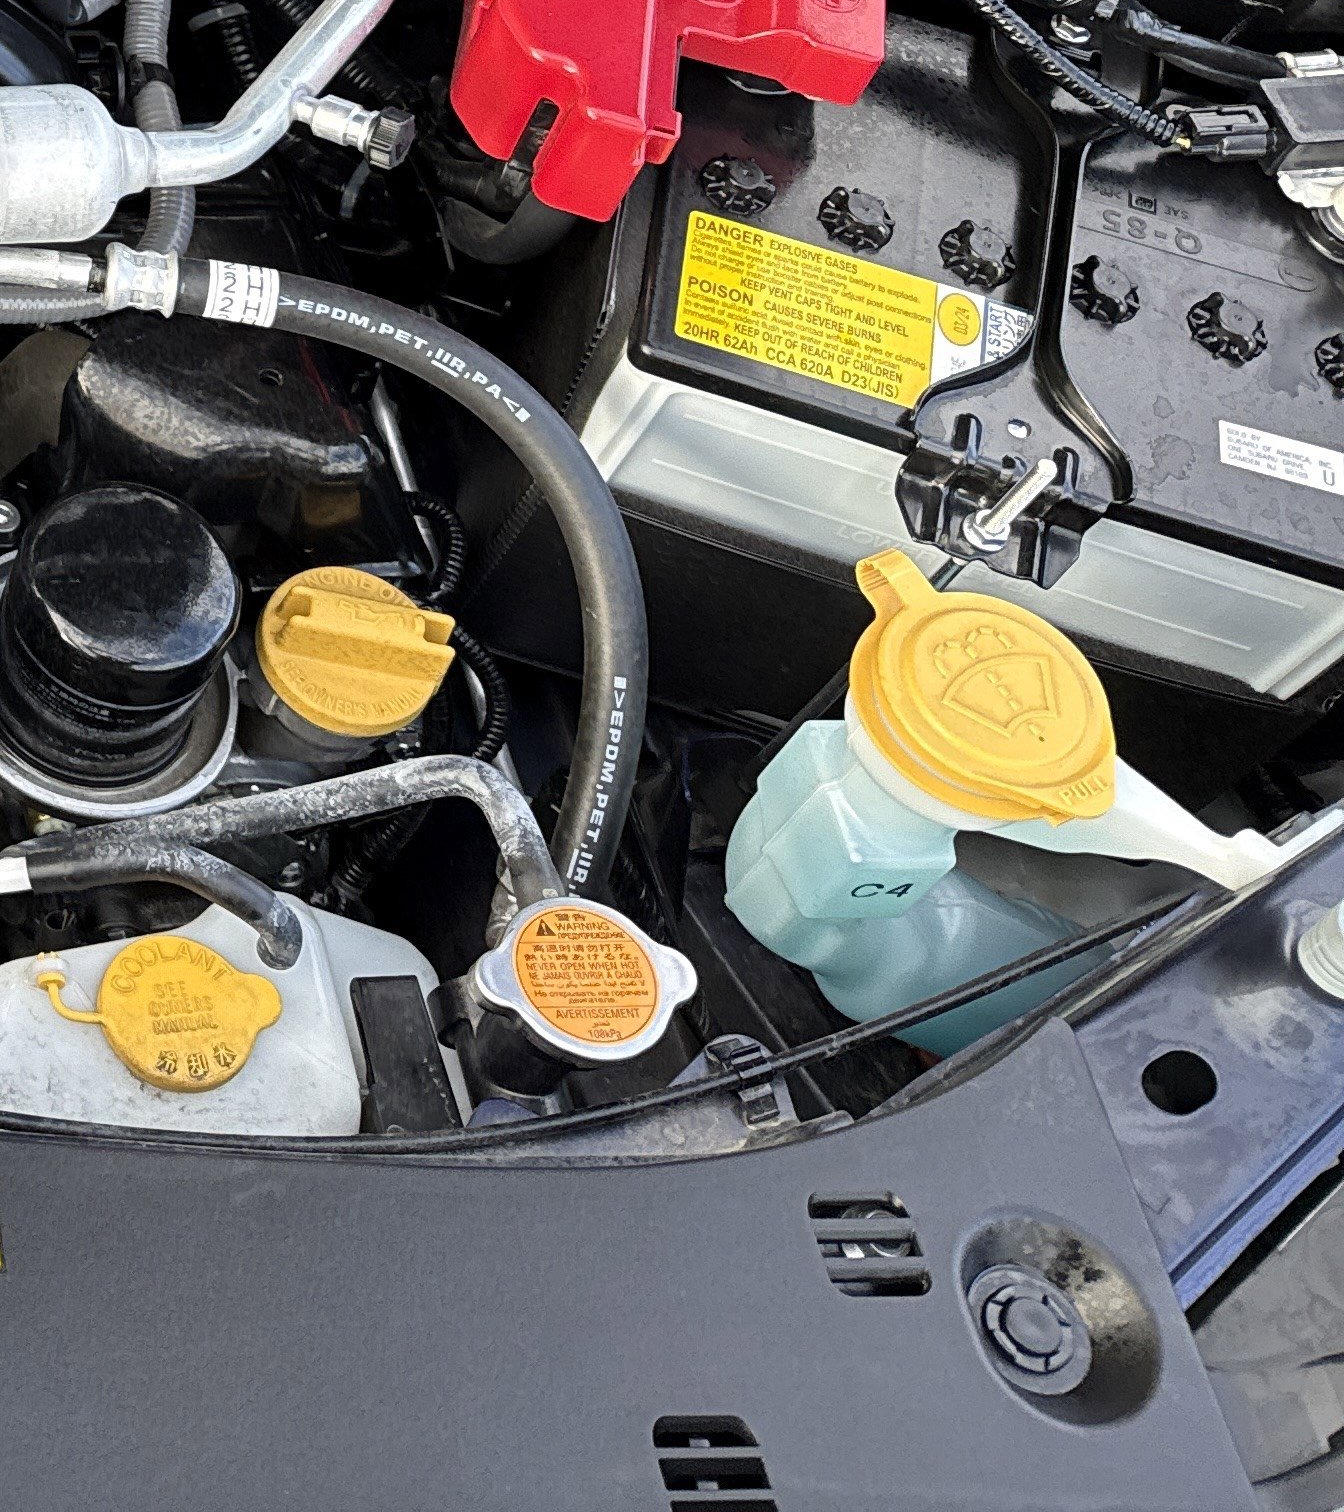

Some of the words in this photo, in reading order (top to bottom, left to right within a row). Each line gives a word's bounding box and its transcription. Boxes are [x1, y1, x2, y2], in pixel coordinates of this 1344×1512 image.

[695, 217, 764, 248] DANGER
[769, 239, 823, 264] EXPLOSIVE
[825, 256, 858, 275] GASES
[1102, 209, 1202, 254] Q-85
[690, 254, 717, 267] without
[720, 263, 744, 275] proper
[746, 270, 785, 287] instruction
[787, 282, 802, 292] and
[692, 238, 719, 252] Always
[802, 270, 819, 280] from
[691, 245, 702, 254] Do
[704, 249, 716, 258] not
[718, 254, 745, 268] charge
[747, 262, 755, 270] or
[757, 265, 770, 274] use
[831, 287, 839, 295] or
[841, 291, 865, 304] adjust
[866, 298, 884, 309] post
[885, 303, 932, 324] connections
[849, 276, 876, 291] battery
[878, 285, 886, 293] to
[688, 275, 754, 307] POISON
[763, 300, 804, 321] CAUSES
[806, 313, 844, 334] SEVERE
[847, 325, 882, 344] BURNS
[740, 277, 766, 293] KEEP
[768, 285, 794, 301] VENT
[795, 293, 822, 311] CAPS
[824, 302, 854, 320] TIGHT
[854, 311, 876, 327] AND
[878, 318, 909, 338] LEVEL
[693, 301, 715, 314] event
[717, 308, 725, 316] of
[727, 311, 759, 326] accident
[823, 341, 838, 351] and
[987, 306, 1004, 347] START
[683, 321, 720, 344] 20HR
[723, 333, 758, 356] 62Ah
[765, 346, 796, 368] CCA
[800, 357, 834, 380] 620A
[841, 370, 899, 400] D23(JIS)
[733, 322, 760, 338] KEEP
[762, 331, 783, 346] OUT
[785, 339, 799, 350] OF
[800, 343, 835, 362] REACH
[837, 354, 851, 366] OF
[853, 359, 903, 384] CHILDREN
[864, 343, 883, 355] eyes
[885, 350, 893, 358] or
[1247, 449, 1278, 463] SUBARU
[1323, 469, 1335, 486] U
[302, 568, 372, 590] NGINE
[1058, 775, 1110, 806] PULL
[850, 882, 914, 898] C4
[555, 921, 610, 931] WARNING
[111, 942, 235, 994] COOLANT
[526, 962, 556, 971] NEVER
[560, 962, 585, 971] OPEN
[588, 961, 618, 971] WHEN
[529, 972, 540, 981] NE
[542, 971, 571, 980] JAMAIS
[574, 970, 603, 979] OUVRIR
[614, 970, 643, 979] CHAUD
[154, 980, 187, 999] SEE
[151, 1015, 219, 1035] MANUAL
[556, 1008, 641, 1019] AVERTISSEMENT
[156, 1041, 238, 1080] 冷却水
